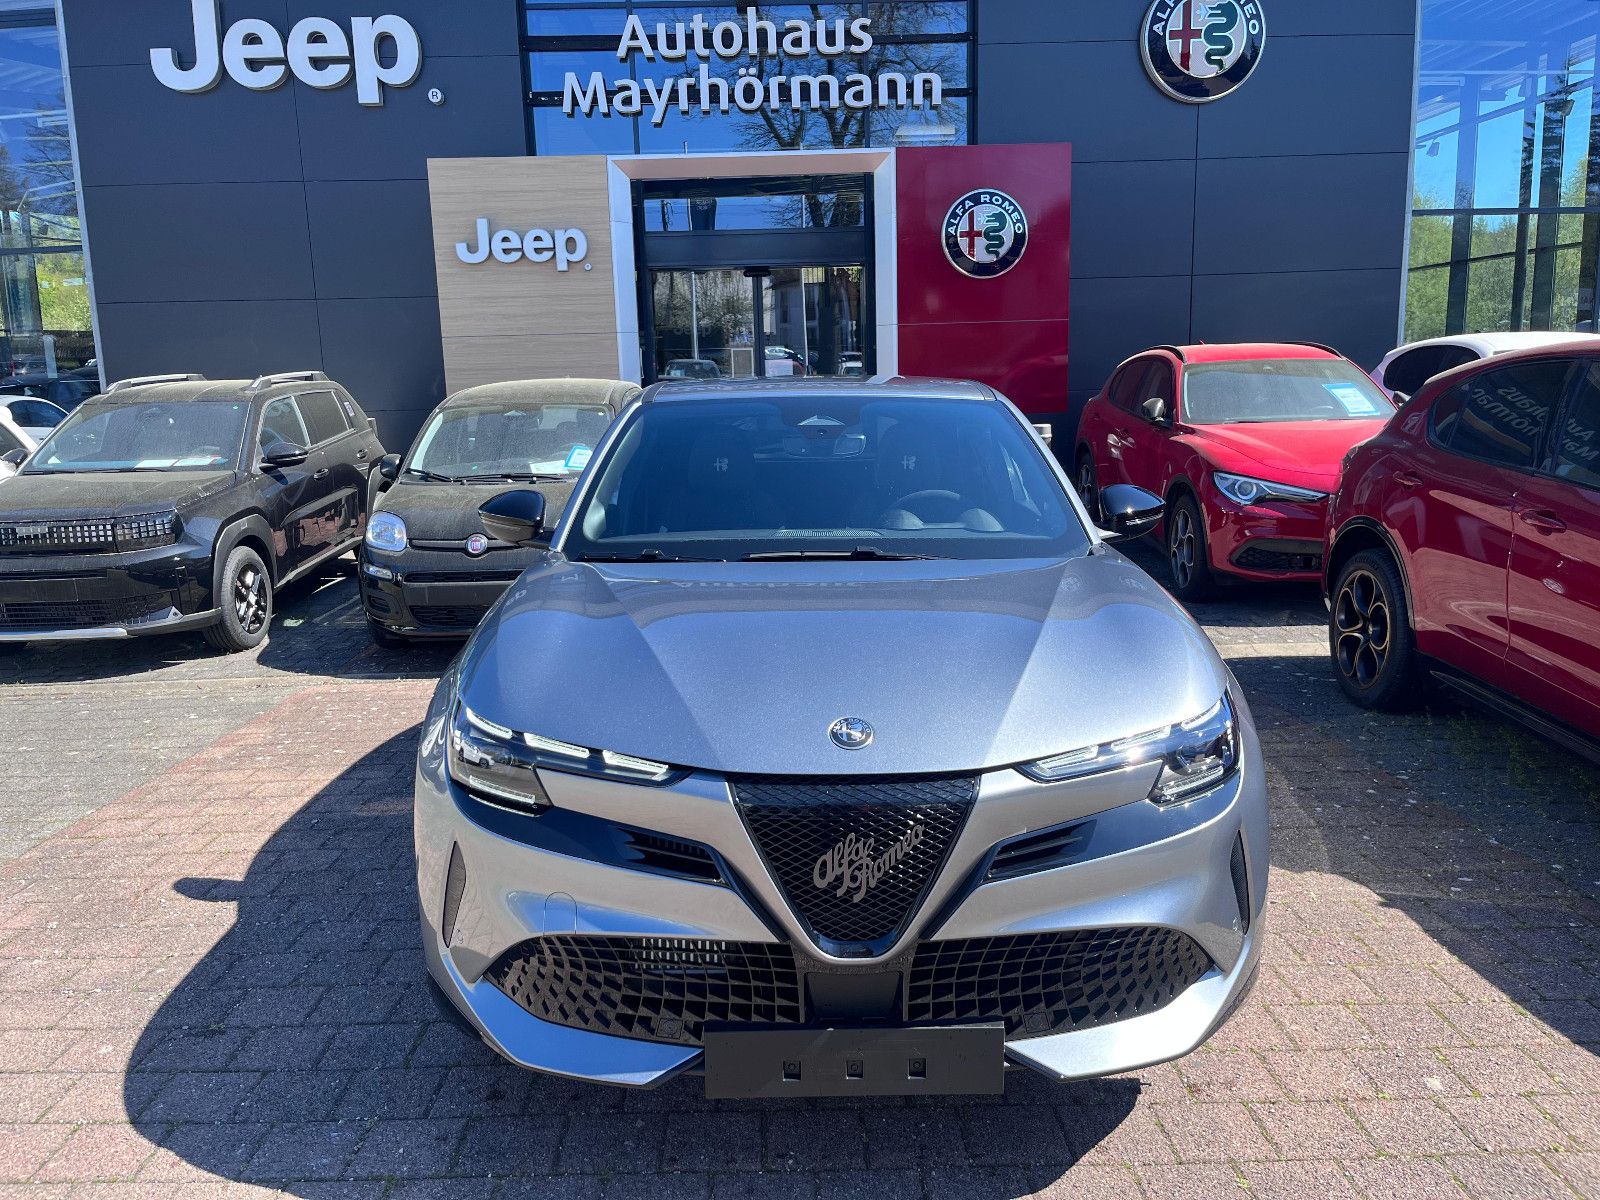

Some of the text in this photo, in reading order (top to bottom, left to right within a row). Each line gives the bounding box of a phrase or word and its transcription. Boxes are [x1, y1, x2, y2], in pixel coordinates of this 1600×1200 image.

[150, 0, 421, 105] Jeep
[616, 6, 874, 59] Autohaus
[562, 63, 943, 126] Mayrhörmann
[948, 194, 1023, 235] ALFA ROMEO
[455, 217, 588, 272] Jeep
[849, 824, 925, 904] Romeo
